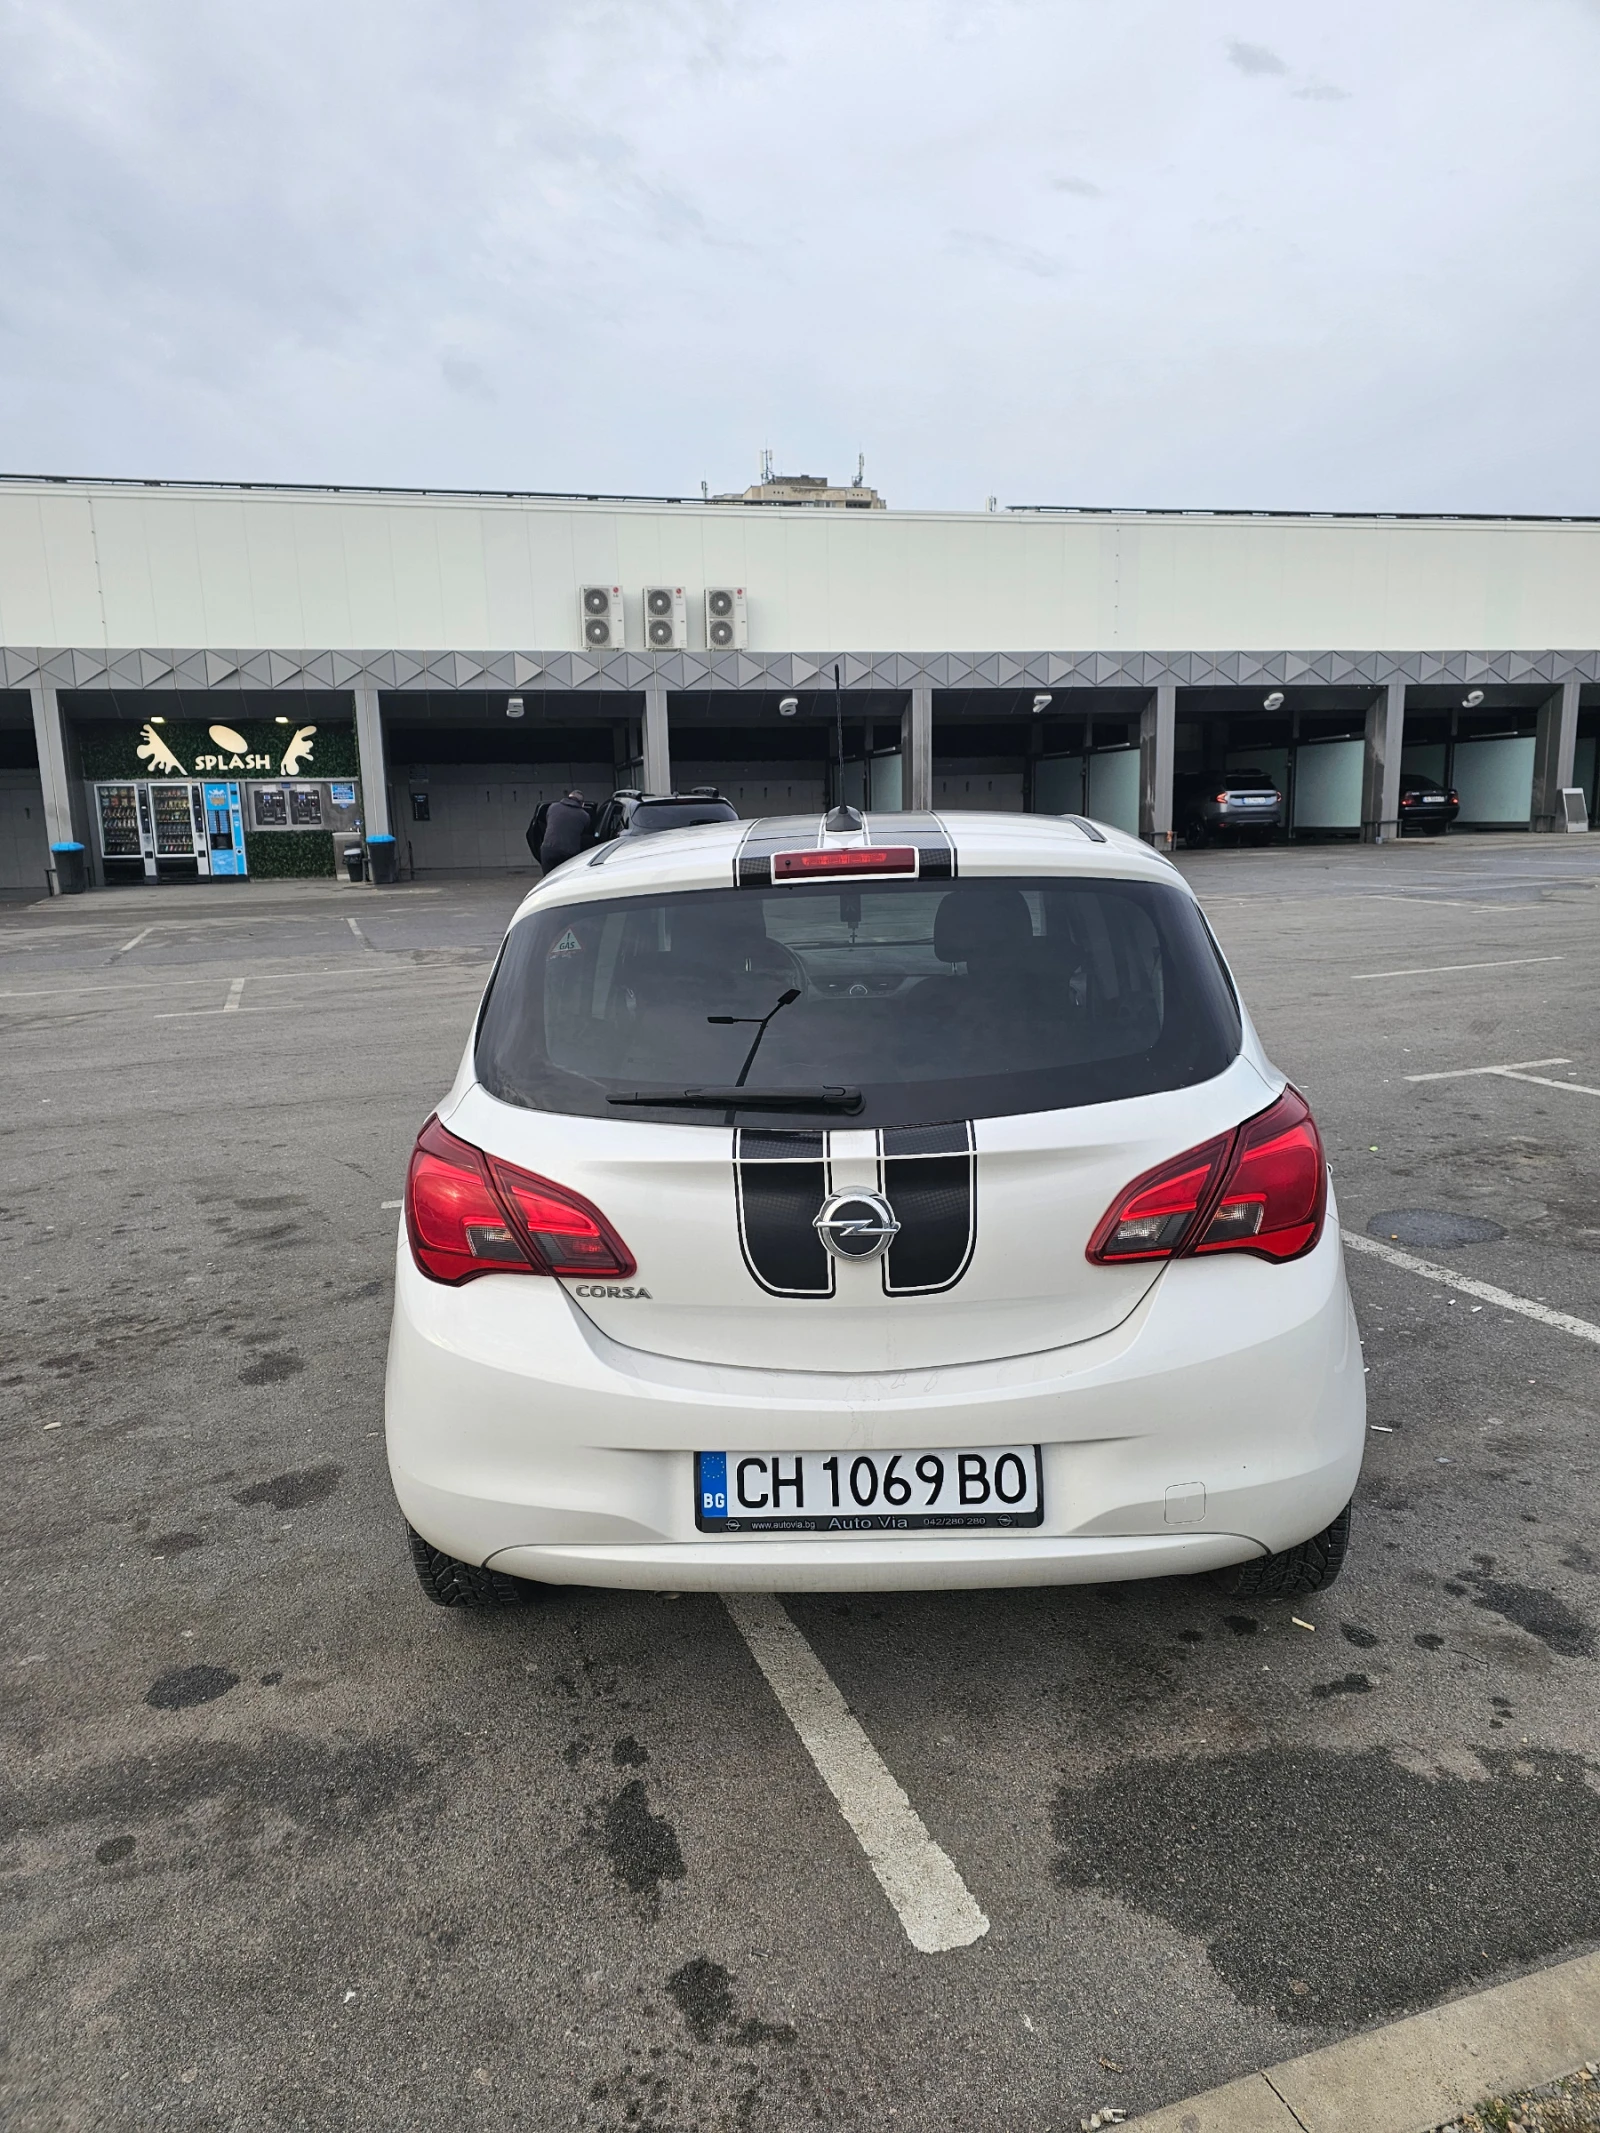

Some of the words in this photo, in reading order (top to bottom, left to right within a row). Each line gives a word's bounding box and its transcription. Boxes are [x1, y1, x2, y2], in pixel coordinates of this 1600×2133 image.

[506, 698, 525, 718] 5
[779, 698, 798, 716] 6
[1033, 695, 1052, 713] 7
[1263, 692, 1285, 711] 8
[1461, 690, 1485, 708] 9
[195, 753, 271, 771] SPLASH
[559, 941, 576, 950] GAS
[575, 1284, 654, 1300] CORSA
[736, 1456, 805, 1510] CH
[822, 1454, 944, 1507] 1069
[703, 1492, 725, 1508] BG
[751, 1519, 816, 1531] www.autovia.bg
[828, 1516, 872, 1530] Auto
[877, 1515, 908, 1529] Via
[923, 1516, 965, 1526] 042/280
[966, 1516, 986, 1526] 280
